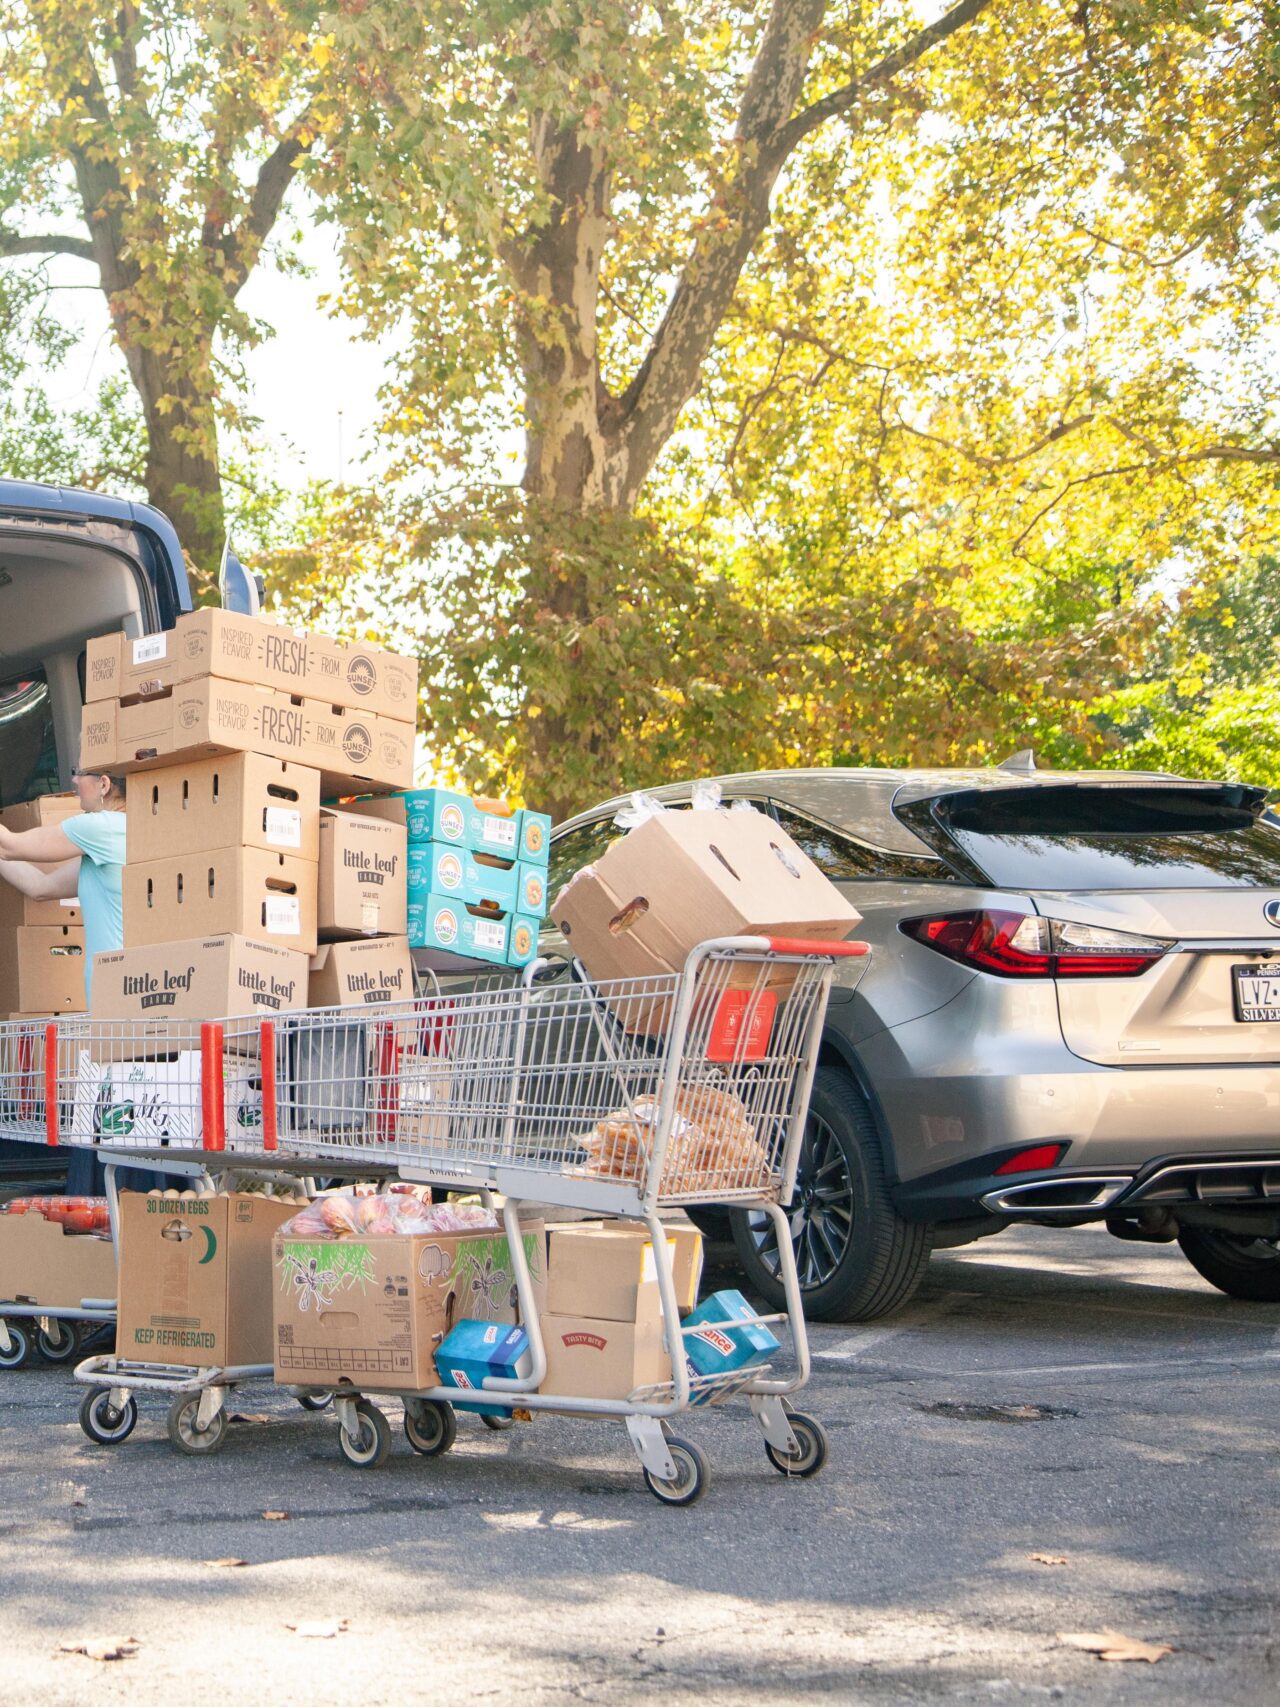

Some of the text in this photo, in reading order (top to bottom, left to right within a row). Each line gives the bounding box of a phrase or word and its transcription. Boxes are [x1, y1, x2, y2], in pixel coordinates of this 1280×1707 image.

[221, 627, 254, 646] INSPIRED
[222, 643, 251, 660] FLAVOR
[91, 657, 116, 670] INSPIRED
[266, 635, 307, 677] FRESH
[321, 657, 340, 676] FROM
[346, 674, 377, 690] SUNSET
[92, 668, 114, 682] FLAVOR
[216, 698, 250, 717] INSPIRED
[87, 721, 111, 735] INSPIRED
[218, 713, 247, 731] FLAVOR
[261, 705, 303, 747] FRESH
[316, 726, 336, 745] FROM
[342, 743, 373, 757] SUNSET
[88, 733, 109, 747] FLAVOR
[440, 820, 463, 831] SUNSET
[343, 848, 370, 870] little
[375, 853, 398, 877] leaf
[439, 870, 461, 881] SUNSET
[435, 925, 457, 936] SUNSET
[123, 966, 195, 996] little leaf
[238, 967, 295, 1003] little leaf
[346, 968, 404, 992] little leaf
[143, 994, 174, 1008] FARMS
[255, 994, 280, 1009] FARMS
[146, 1200, 209, 1215] 30 DOZEN EGGS
[134, 1328, 216, 1349] KEEP REFRIGERATED
[565, 1335, 602, 1347] TASTY BITE
[702, 1323, 732, 1352] ance
